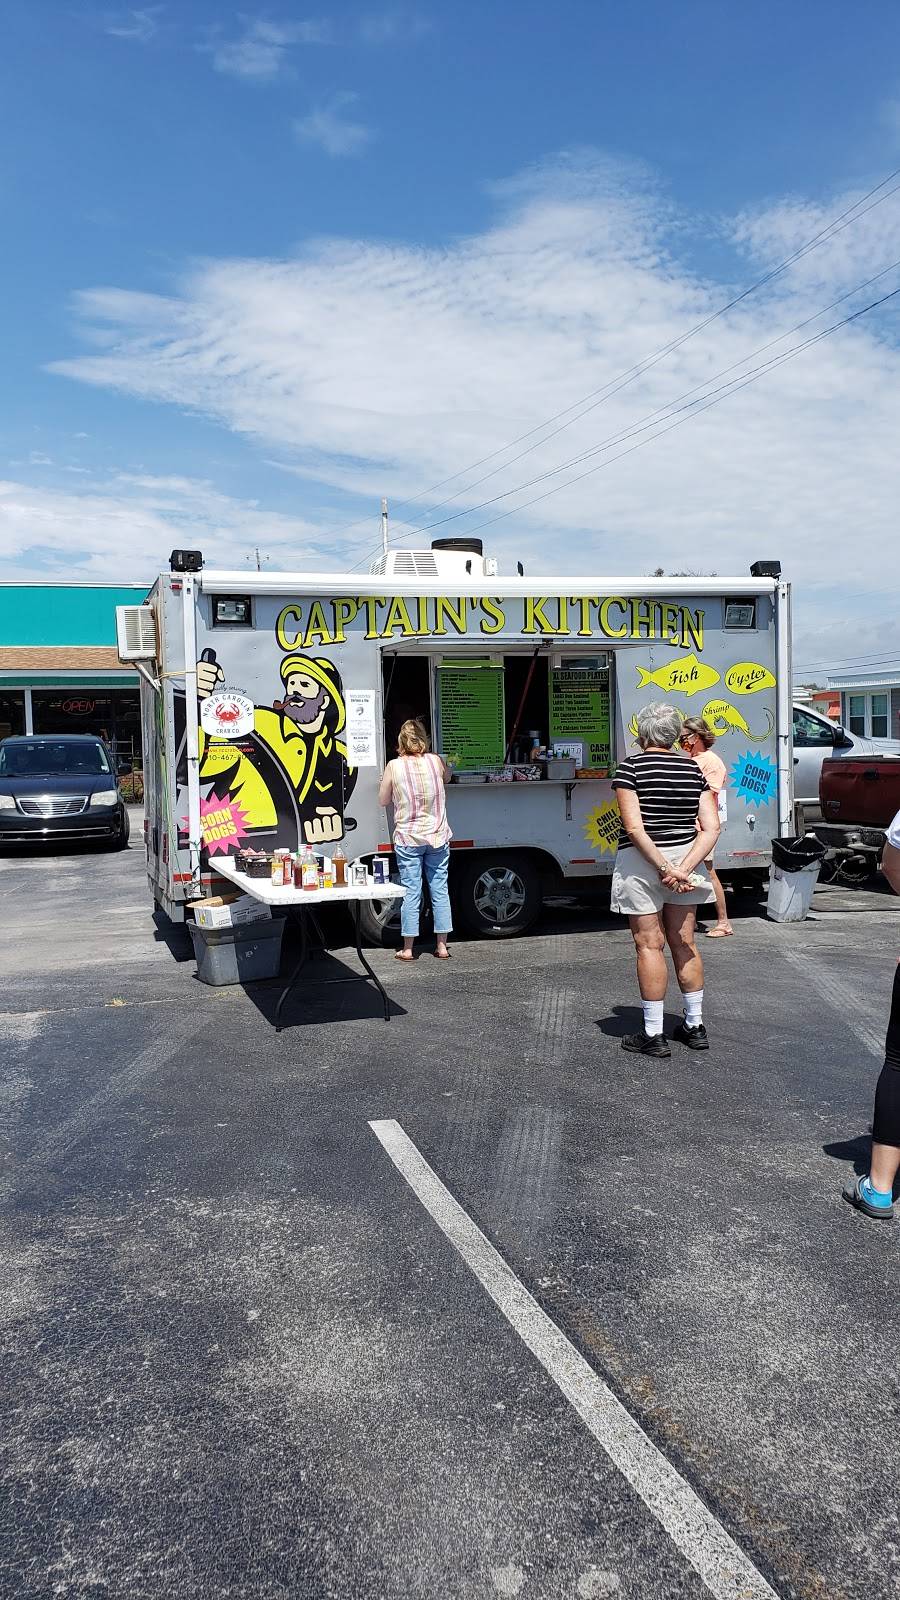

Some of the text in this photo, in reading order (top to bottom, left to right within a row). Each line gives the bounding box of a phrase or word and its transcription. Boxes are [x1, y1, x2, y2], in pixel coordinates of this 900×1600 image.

[275, 596, 706, 653] CAPTAIN'S KITCHEN
[560, 671, 586, 680] SEAFOOD
[587, 671, 608, 680] PLATES
[668, 666, 699, 686] Fish
[728, 669, 766, 690] Oyster
[62, 700, 95, 711] OPEN
[202, 695, 253, 717] NORTH CAROLINA
[704, 703, 730, 717] Shrimp
[590, 743, 609, 763] CASH ONLY
[744, 763, 771, 782] CORN
[740, 775, 768, 796] DOGS
[200, 808, 233, 829] CORN
[596, 809, 617, 827] CHILI
[203, 821, 237, 844] DOGS
